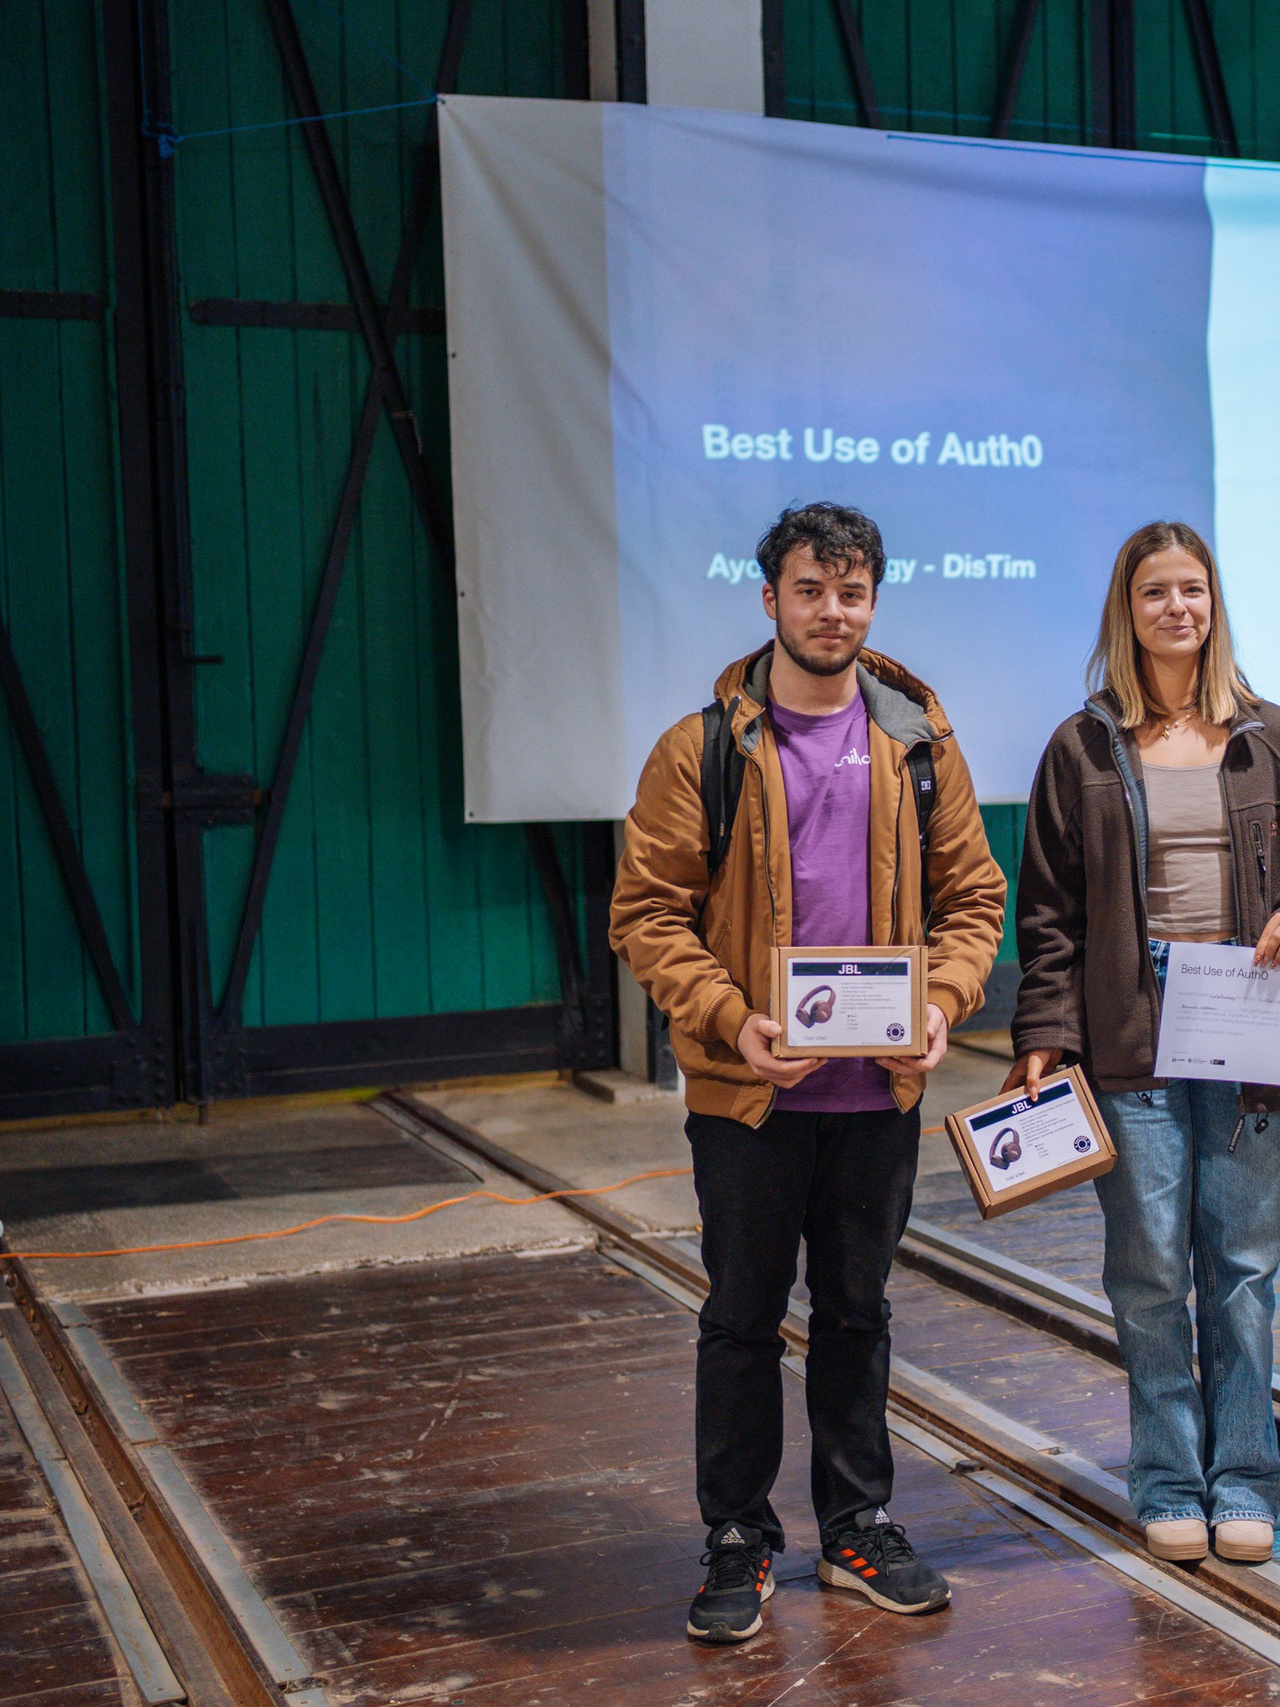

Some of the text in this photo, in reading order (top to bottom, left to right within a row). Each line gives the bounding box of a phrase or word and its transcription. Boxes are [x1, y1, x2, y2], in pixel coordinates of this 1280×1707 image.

[702, 424, 1043, 468] Best Use of Auth0
[943, 553, 1037, 579] DisTim
[838, 964, 862, 975] JBL
[1181, 964, 1269, 981] Best Use of Auth0
[1011, 1100, 1032, 1115] JBL
[720, 1537, 746, 1545] adidas
